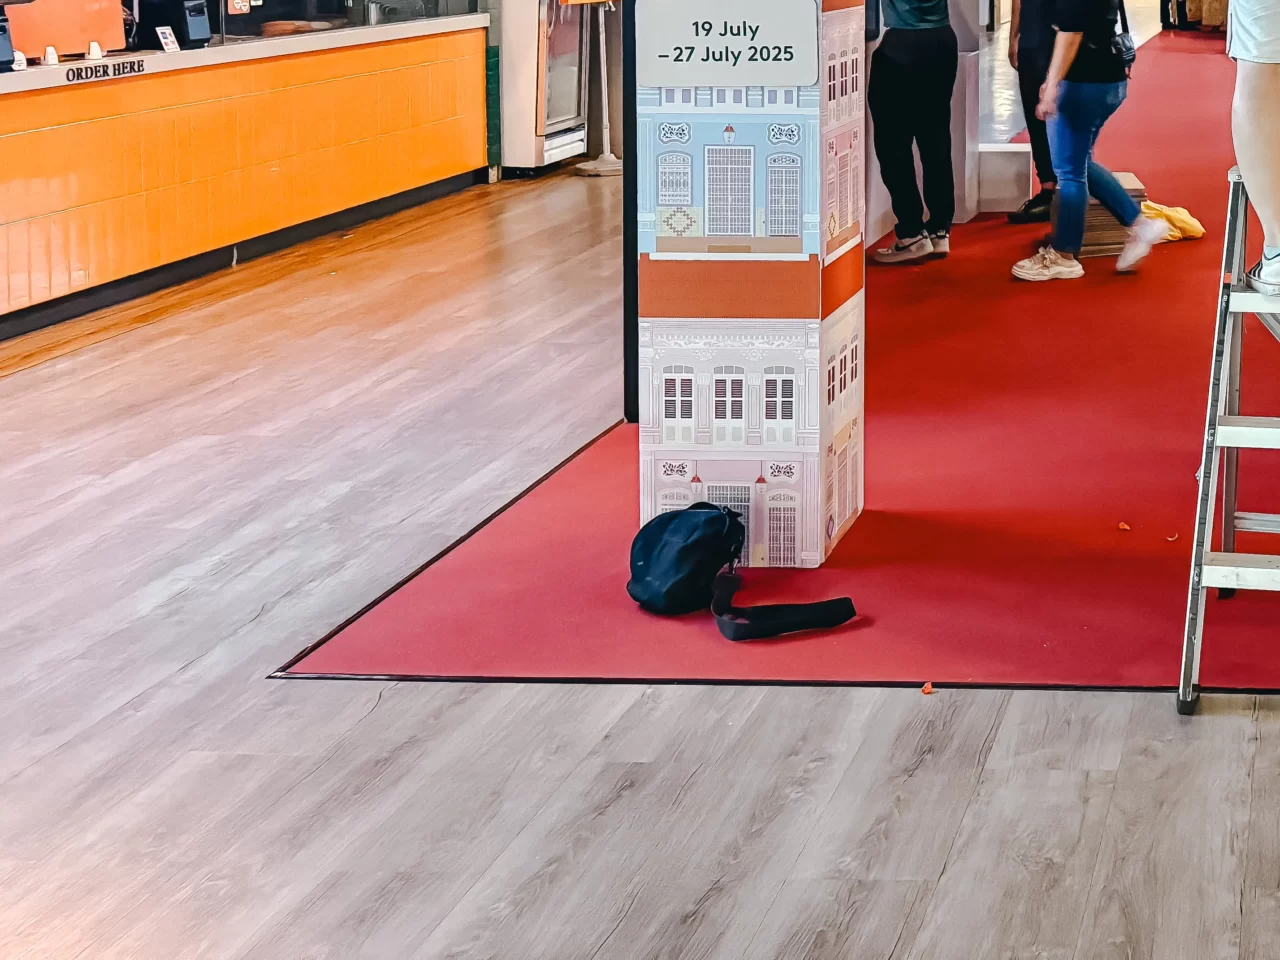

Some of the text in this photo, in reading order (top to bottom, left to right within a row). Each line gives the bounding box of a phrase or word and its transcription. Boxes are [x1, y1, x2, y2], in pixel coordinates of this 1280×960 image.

[691, 21, 760, 41] 19 July
[701, 46, 742, 67] July
[747, 45, 794, 62] 2025
[66, 59, 145, 82] ORDER HERE
